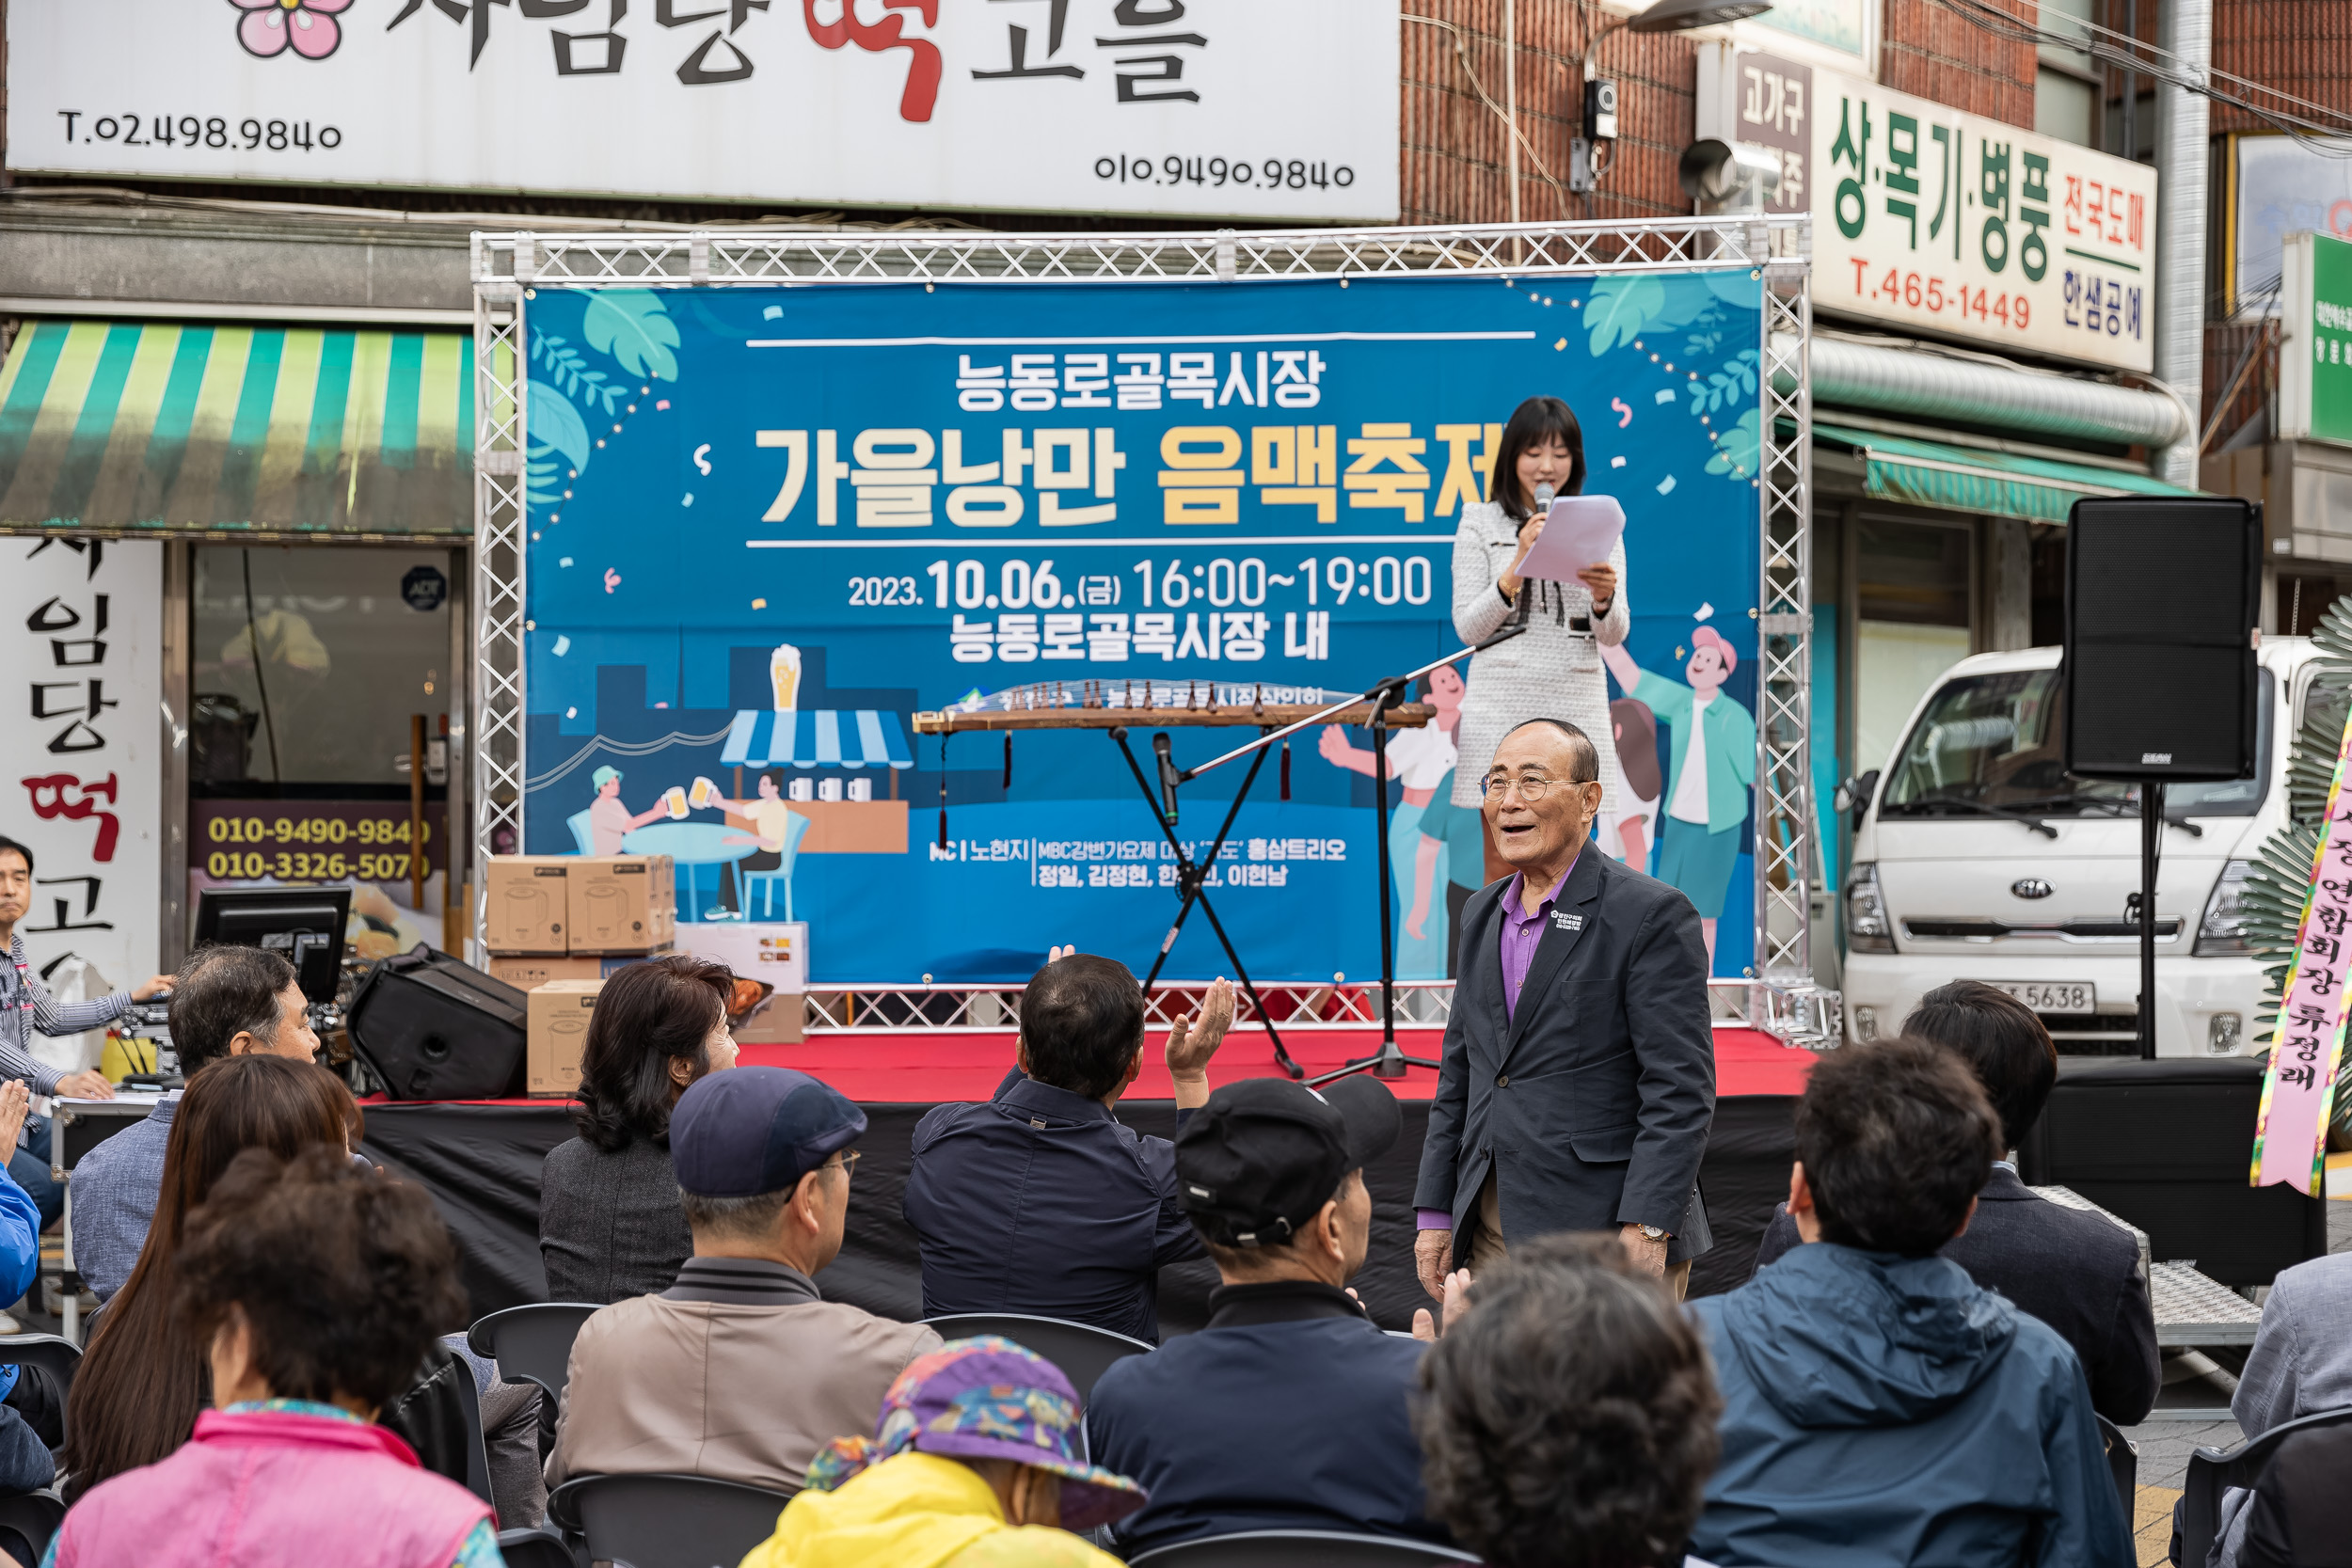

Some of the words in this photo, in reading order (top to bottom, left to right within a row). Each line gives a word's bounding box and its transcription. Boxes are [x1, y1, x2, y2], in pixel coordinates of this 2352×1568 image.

[1742, 65, 1805, 136] 고가구
[58, 111, 342, 151] T.02.498.9840
[1095, 153, 1355, 190] 010.9490.9840
[2065, 174, 2145, 251] 전국도매
[1851, 258, 2030, 330] T.465-1449
[2064, 270, 2143, 341] 한샘공예
[956, 350, 1326, 412] 능동로골목시장
[755, 427, 1126, 529] 가을낭만
[848, 576, 924, 608] 2023.
[1133, 556, 1431, 609] 16:00~19:00
[949, 612, 1270, 662] 능동로골목시장
[1284, 610, 1329, 661] 내
[1038, 863, 1084, 888] 정일,
[1248, 837, 1346, 861] 홍삼트리오
[2026, 986, 2085, 1008] 5638
